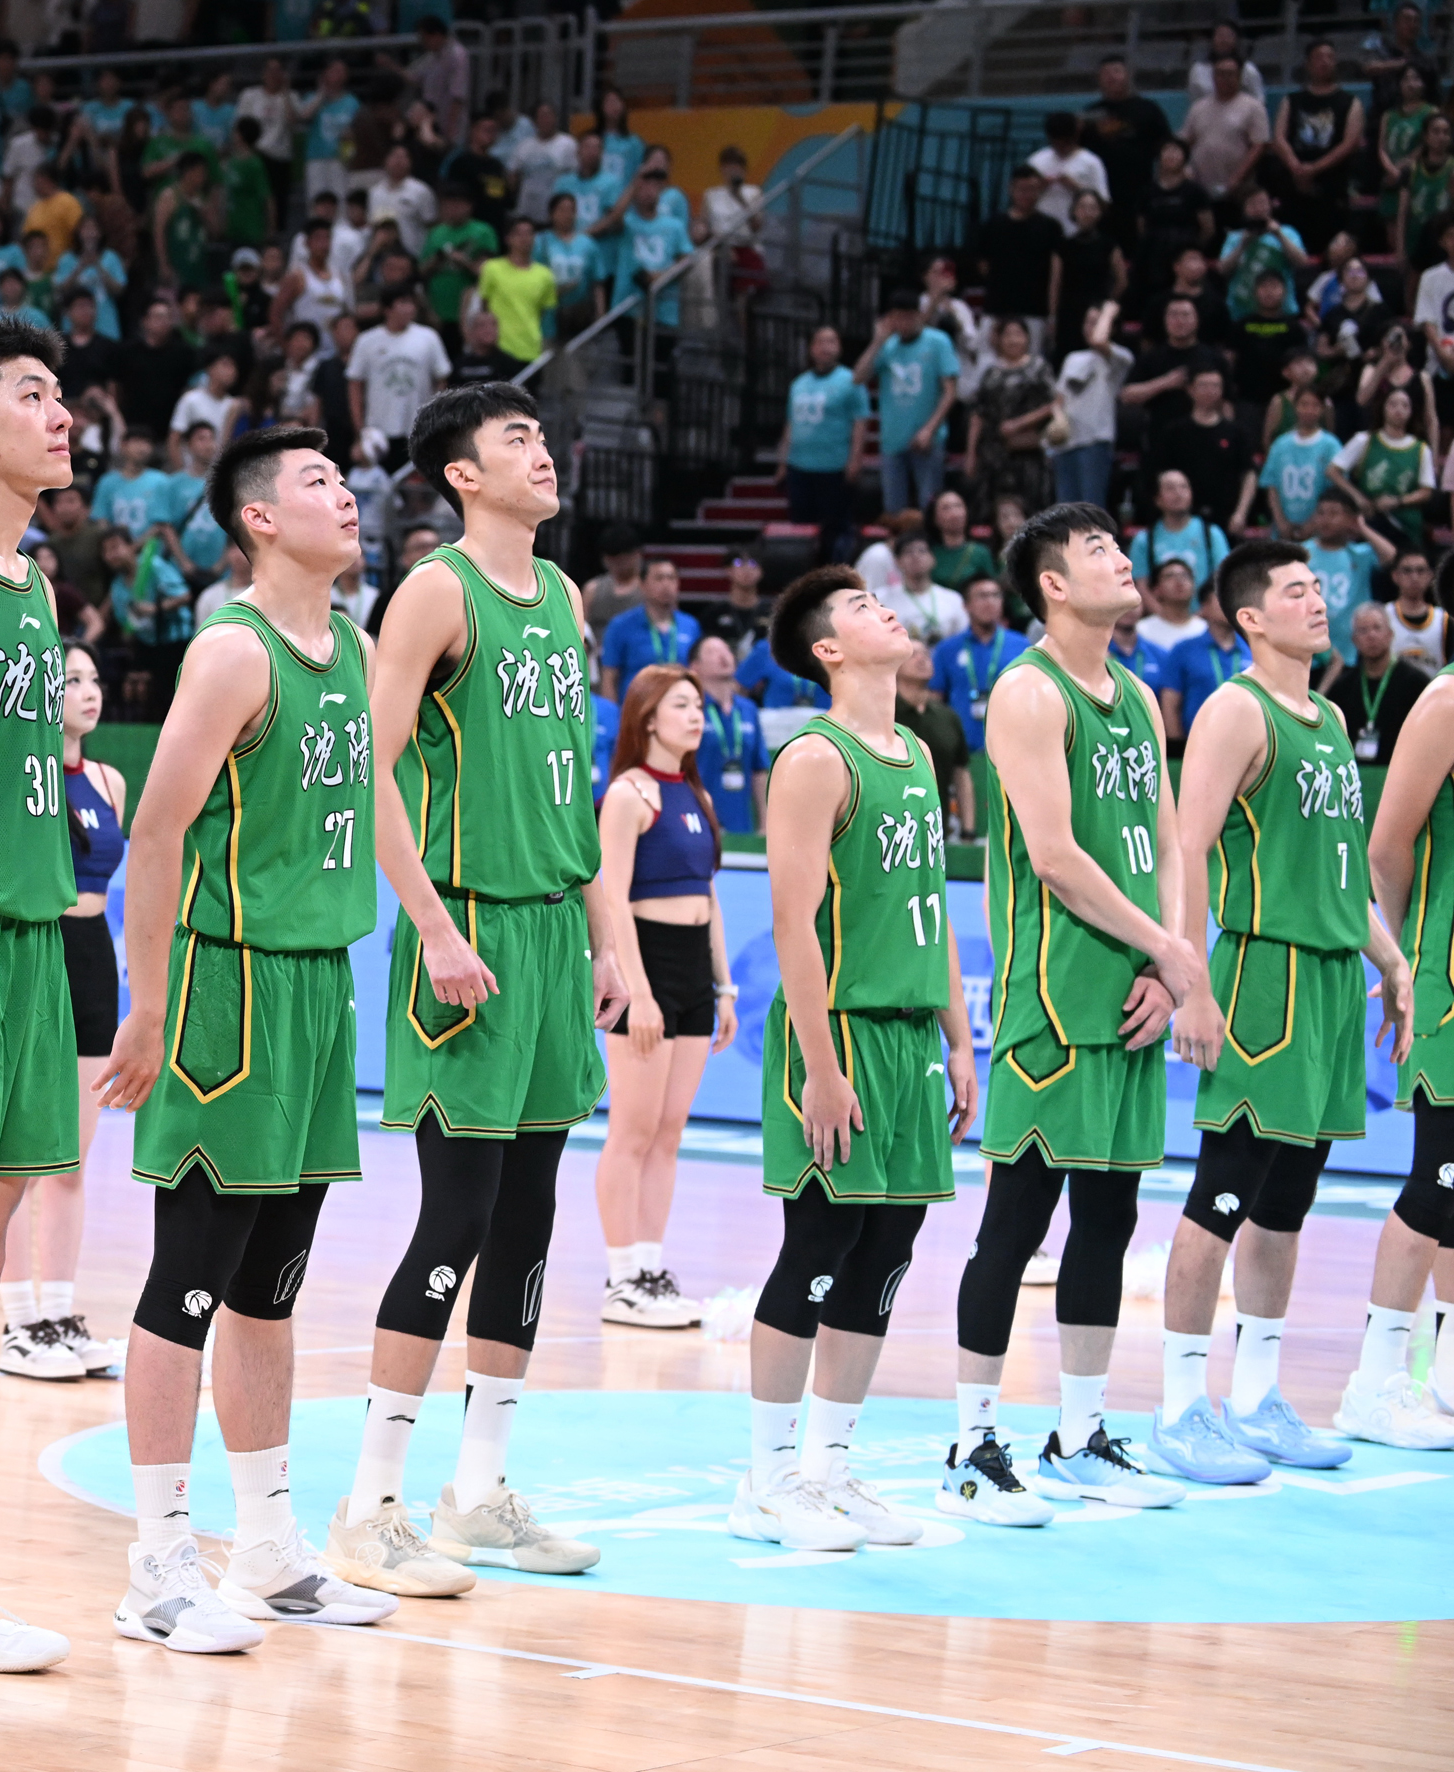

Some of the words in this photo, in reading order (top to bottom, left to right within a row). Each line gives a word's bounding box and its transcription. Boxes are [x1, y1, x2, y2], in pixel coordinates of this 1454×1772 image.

[1282, 465, 1316, 499] 03
[24, 753, 59, 817] 30
[546, 749, 574, 806] 17
[322, 808, 355, 870] 27
[1122, 825, 1154, 875] 10
[1337, 842, 1348, 890] 7
[907, 892, 941, 947] 11
